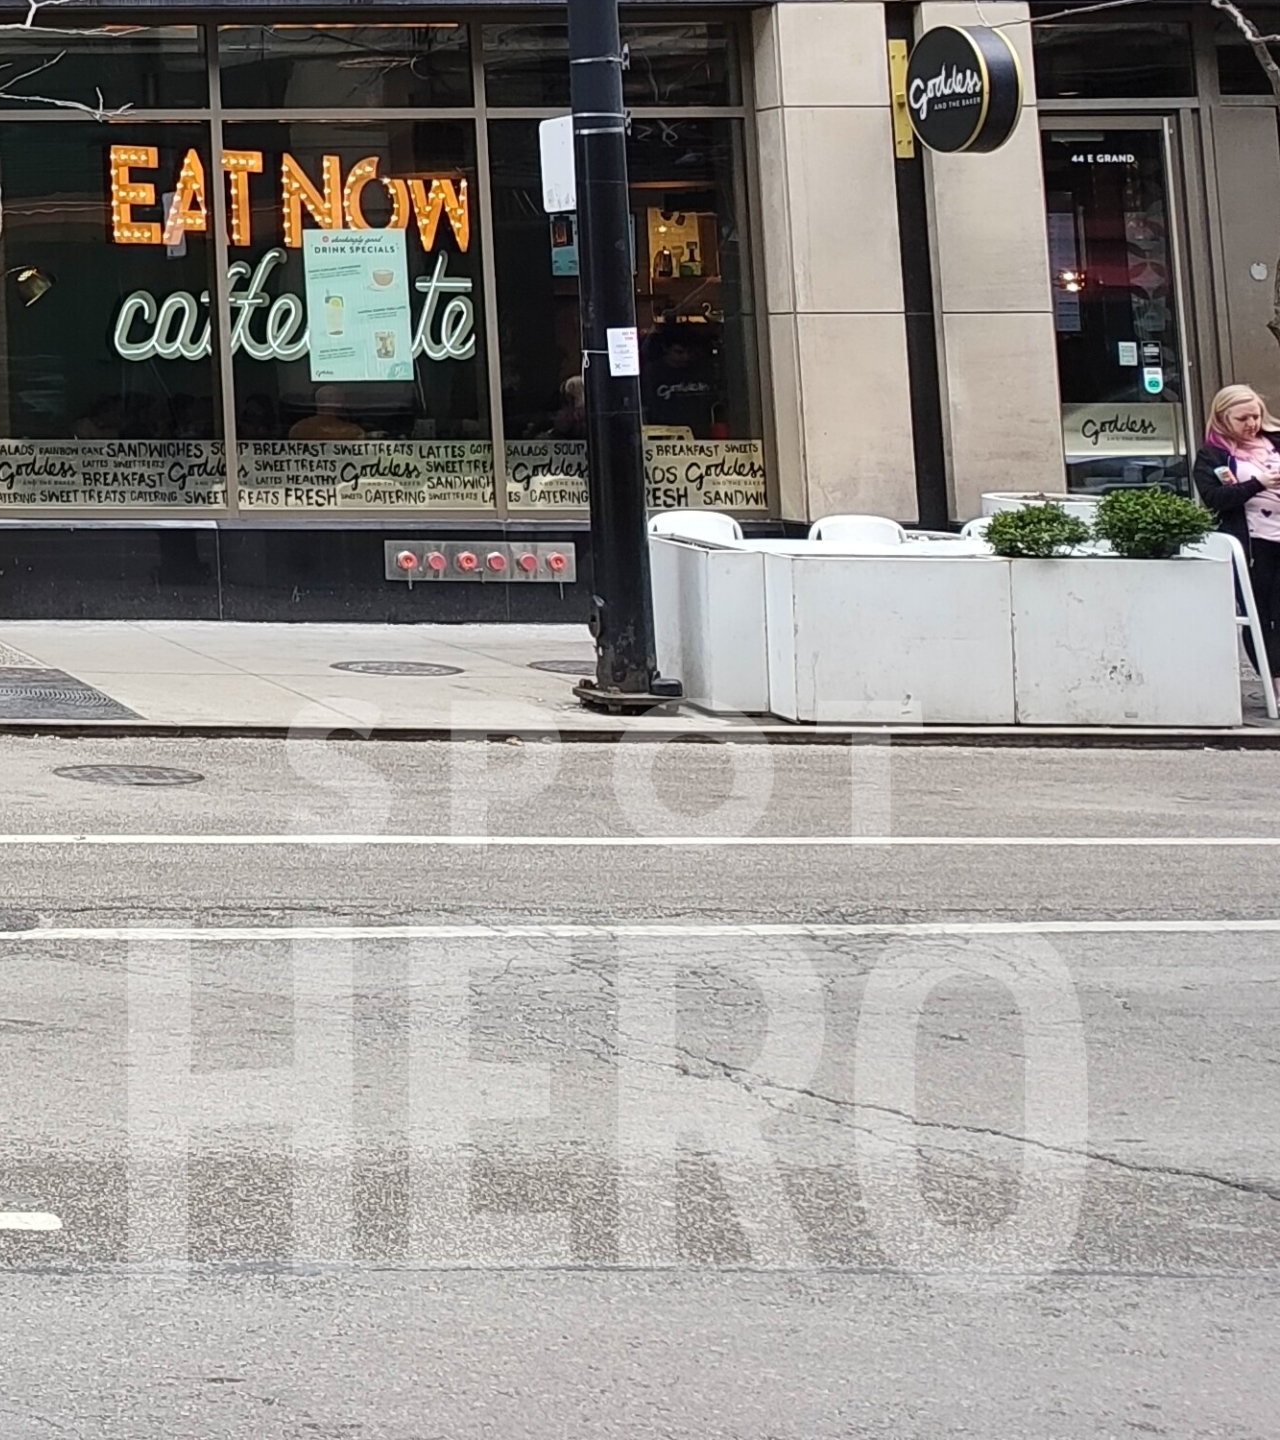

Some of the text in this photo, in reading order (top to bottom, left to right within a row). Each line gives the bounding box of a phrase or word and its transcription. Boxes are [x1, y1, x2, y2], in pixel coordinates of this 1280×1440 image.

[909, 62, 982, 121] Goddess
[934, 102, 947, 110] AND
[962, 97, 981, 106] BAKER
[1071, 154, 1135, 163] 44 E GRAND
[110, 144, 470, 253] EAT NOW
[314, 246, 395, 254] DRINK SPECIALS
[1082, 414, 1157, 446] Goddess
[106, 442, 204, 459] SANDWICHES
[253, 442, 327, 457] BREAKFAST
[333, 443, 370, 456] SWEET
[372, 443, 414, 456] TREATS
[419, 445, 466, 459] LATTES
[507, 445, 549, 456] SALADS
[554, 443, 585, 456] SOUP
[656, 444, 720, 457] BREAKFAST
[725, 443, 759, 453] SWEETS
[82, 459, 108, 468] LATTES
[255, 459, 292, 472] SWEET
[294, 459, 337, 472] TREATS
[426, 460, 464, 473] SWEET
[340, 456, 422, 491] Goddess
[685, 456, 766, 492] Goddess
[82, 472, 165, 488] BREAKFAST
[256, 476, 282, 485] LATTES
[286, 474, 338, 485] HEALTHY
[40, 489, 80, 503] SWEET
[81, 490, 126, 503] TREATS
[130, 490, 178, 503] CATERING
[184, 490, 228, 505] SWEET
[238, 489, 280, 506] REATS
[284, 487, 338, 507] FRESH
[365, 489, 426, 504] CATERING
[530, 489, 589, 504] CATERING
[703, 490, 767, 506] SANDWI
